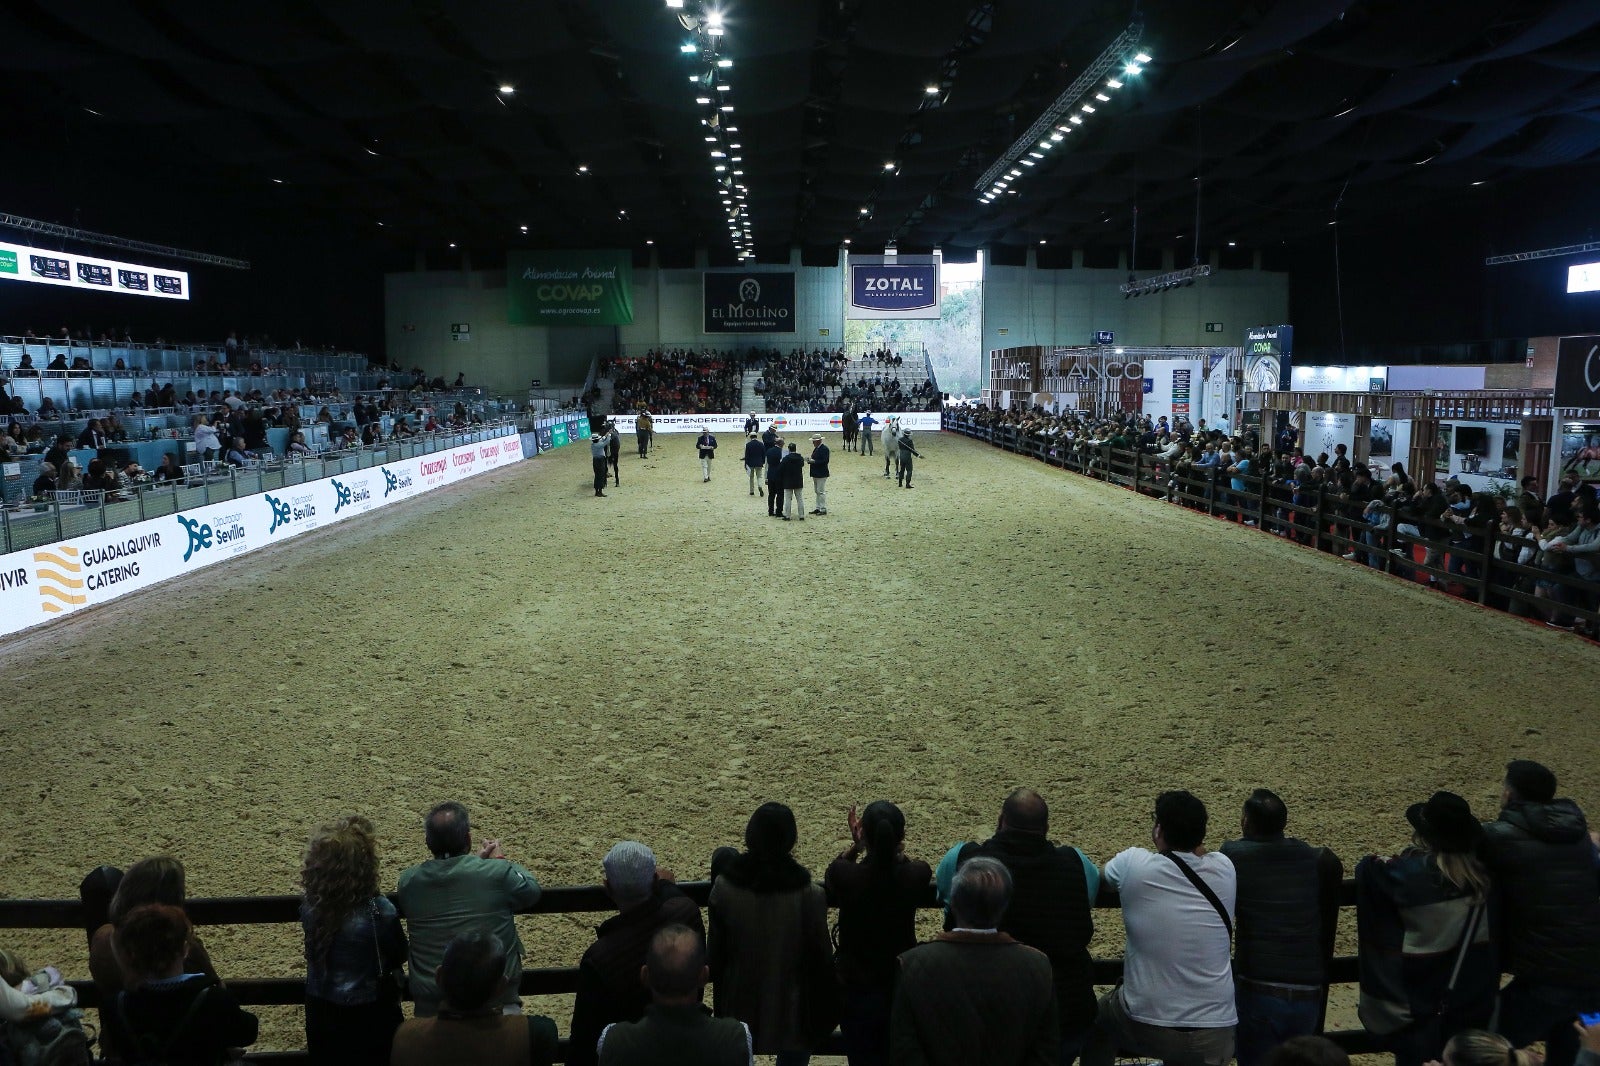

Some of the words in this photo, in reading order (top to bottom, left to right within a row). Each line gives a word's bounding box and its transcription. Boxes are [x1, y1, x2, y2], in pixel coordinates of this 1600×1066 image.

[536, 284, 604, 301] COVAP
[865, 278, 923, 291] ZOTAL
[712, 308, 725, 318] EL
[1067, 361, 1143, 380] ANCC
[899, 418, 918, 426] CEU
[293, 504, 316, 521] Sevilla
[216, 523, 246, 545] Sevilla
[82, 532, 162, 567] GUADALQUIVIR
[0, 567, 28, 591] IVIR
[87, 561, 140, 591] CATERING
